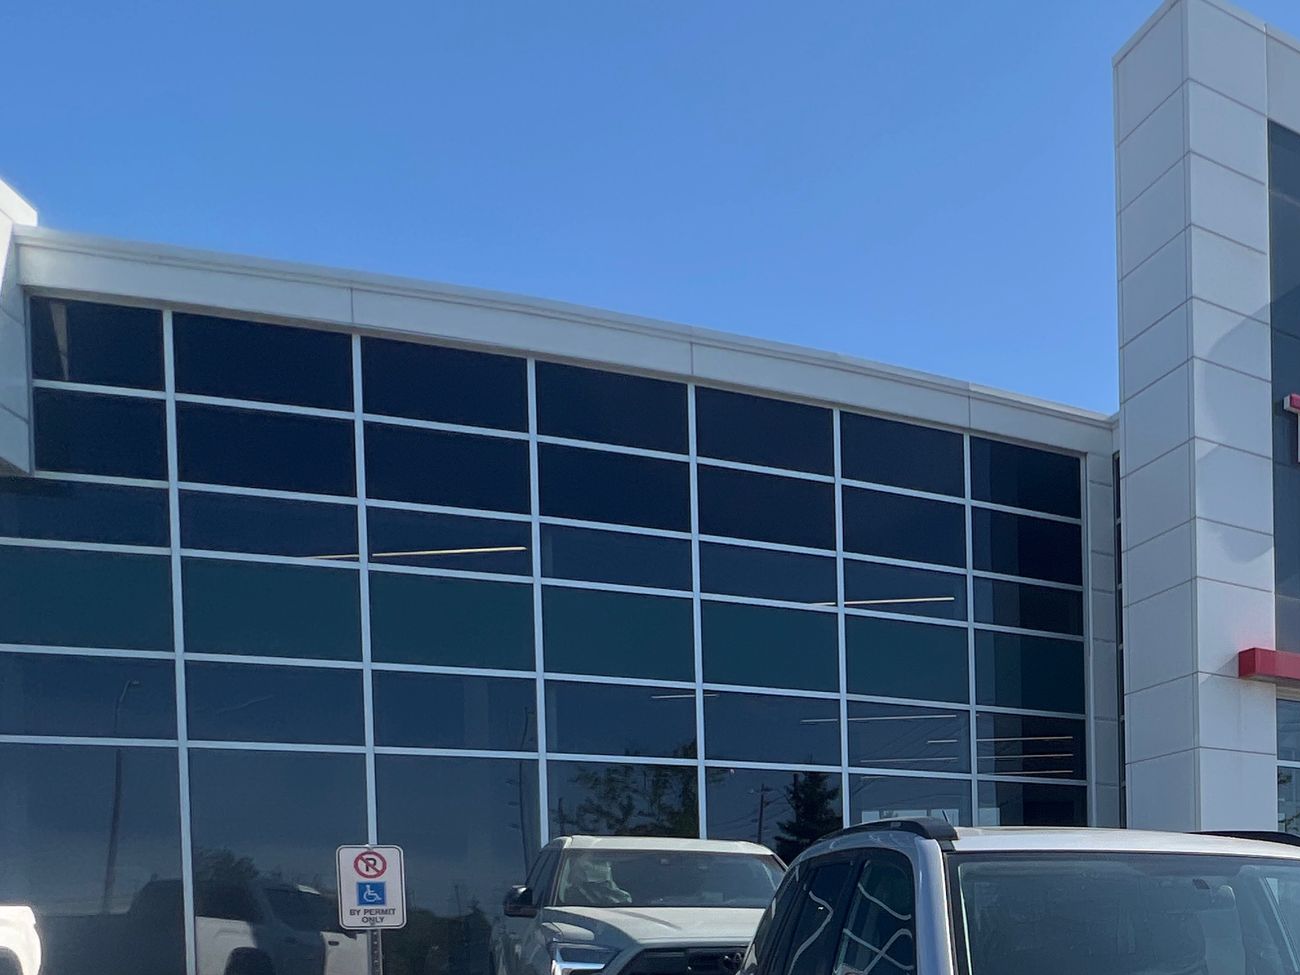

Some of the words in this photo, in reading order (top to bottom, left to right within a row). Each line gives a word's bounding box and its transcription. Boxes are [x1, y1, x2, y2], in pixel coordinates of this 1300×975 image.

[349, 908, 361, 916] BY
[363, 908, 396, 916] PERMIT
[361, 916, 385, 924] ONLY
